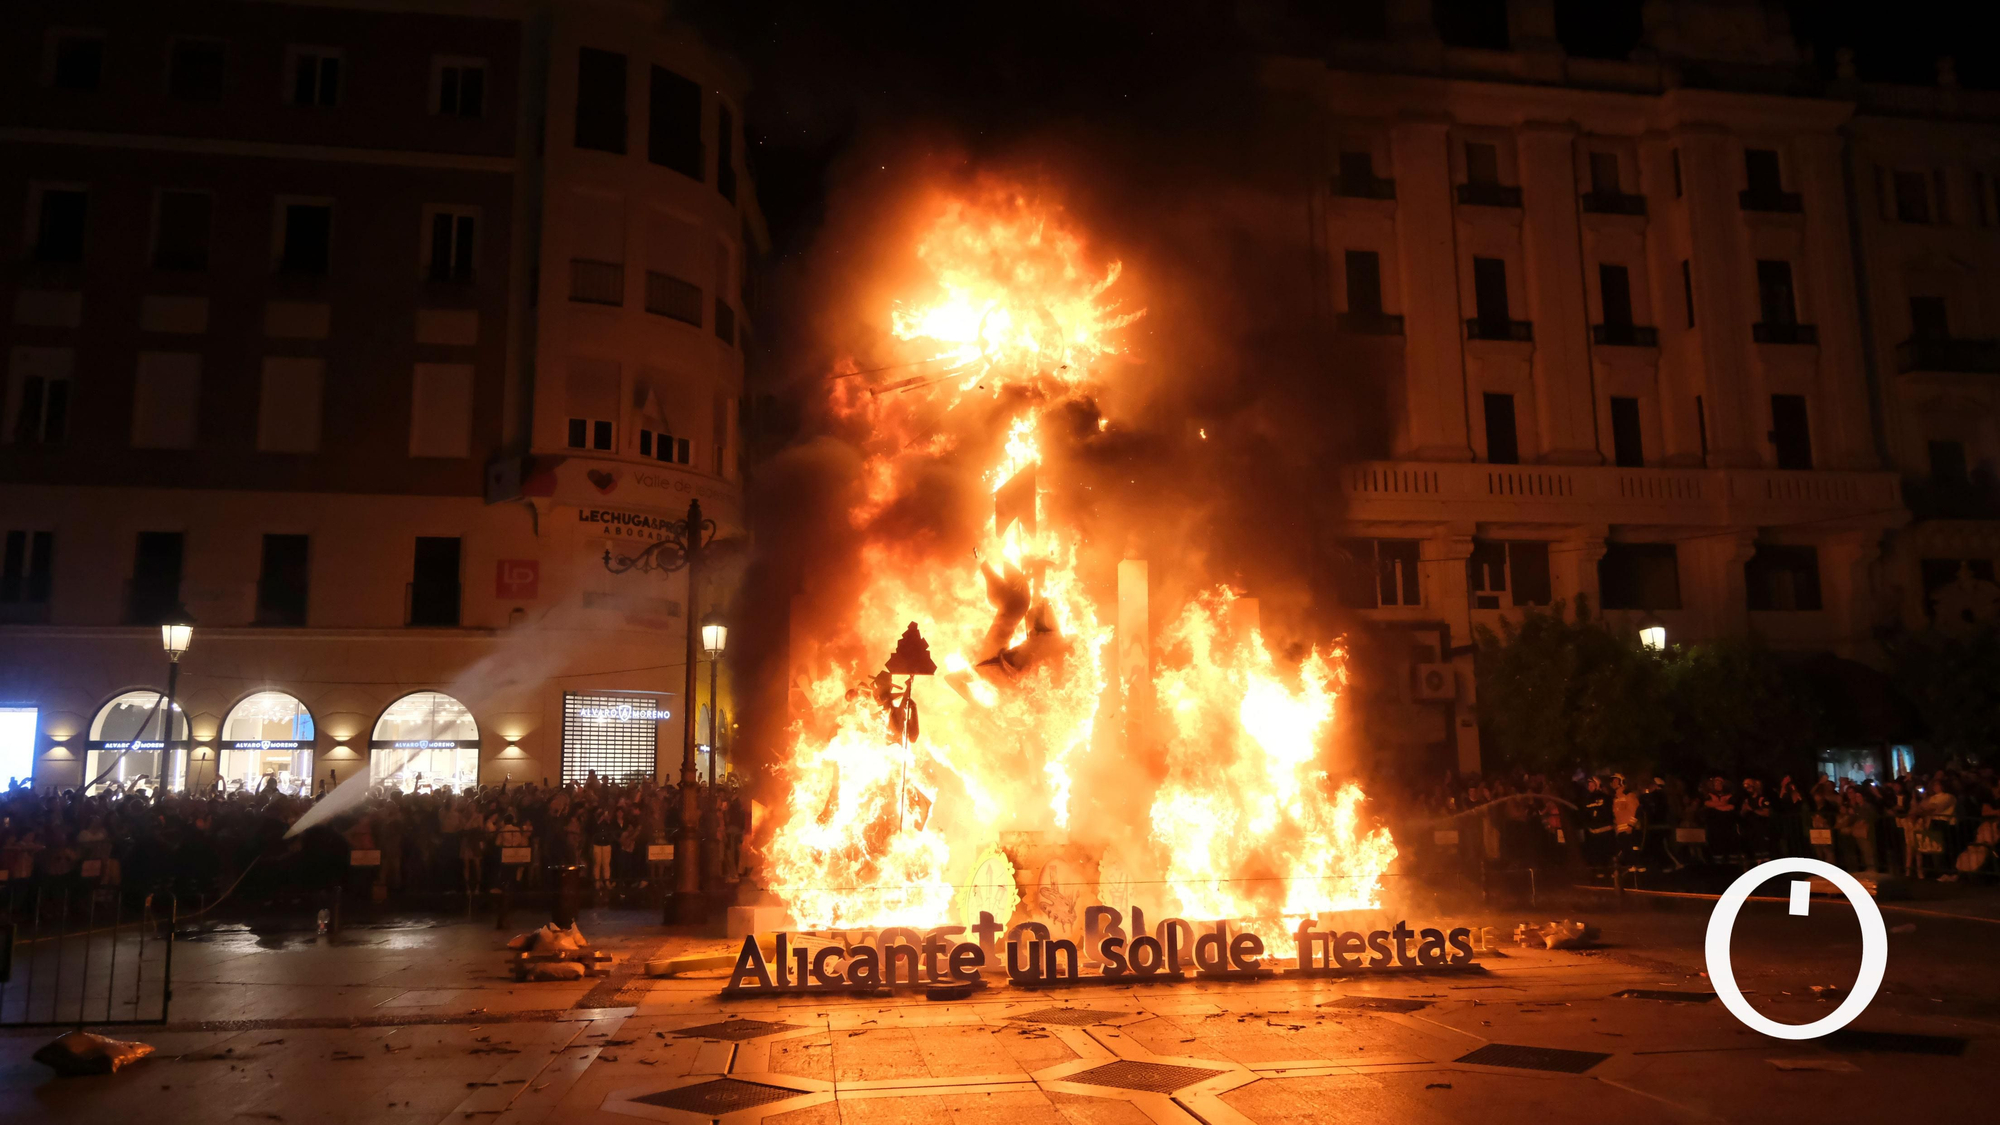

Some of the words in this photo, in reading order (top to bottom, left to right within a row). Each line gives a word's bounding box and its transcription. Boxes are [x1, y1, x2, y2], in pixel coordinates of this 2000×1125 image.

[633, 471, 670, 490] Valle
[674, 479, 692, 494] de
[580, 707, 617, 717] ALVARO
[632, 710, 671, 719] MORENO
[728, 931, 985, 990] Alicante
[1006, 936, 1079, 982] un
[1100, 920, 1184, 977] sol
[1195, 918, 1264, 972] de
[1293, 918, 1475, 971] fiestas
